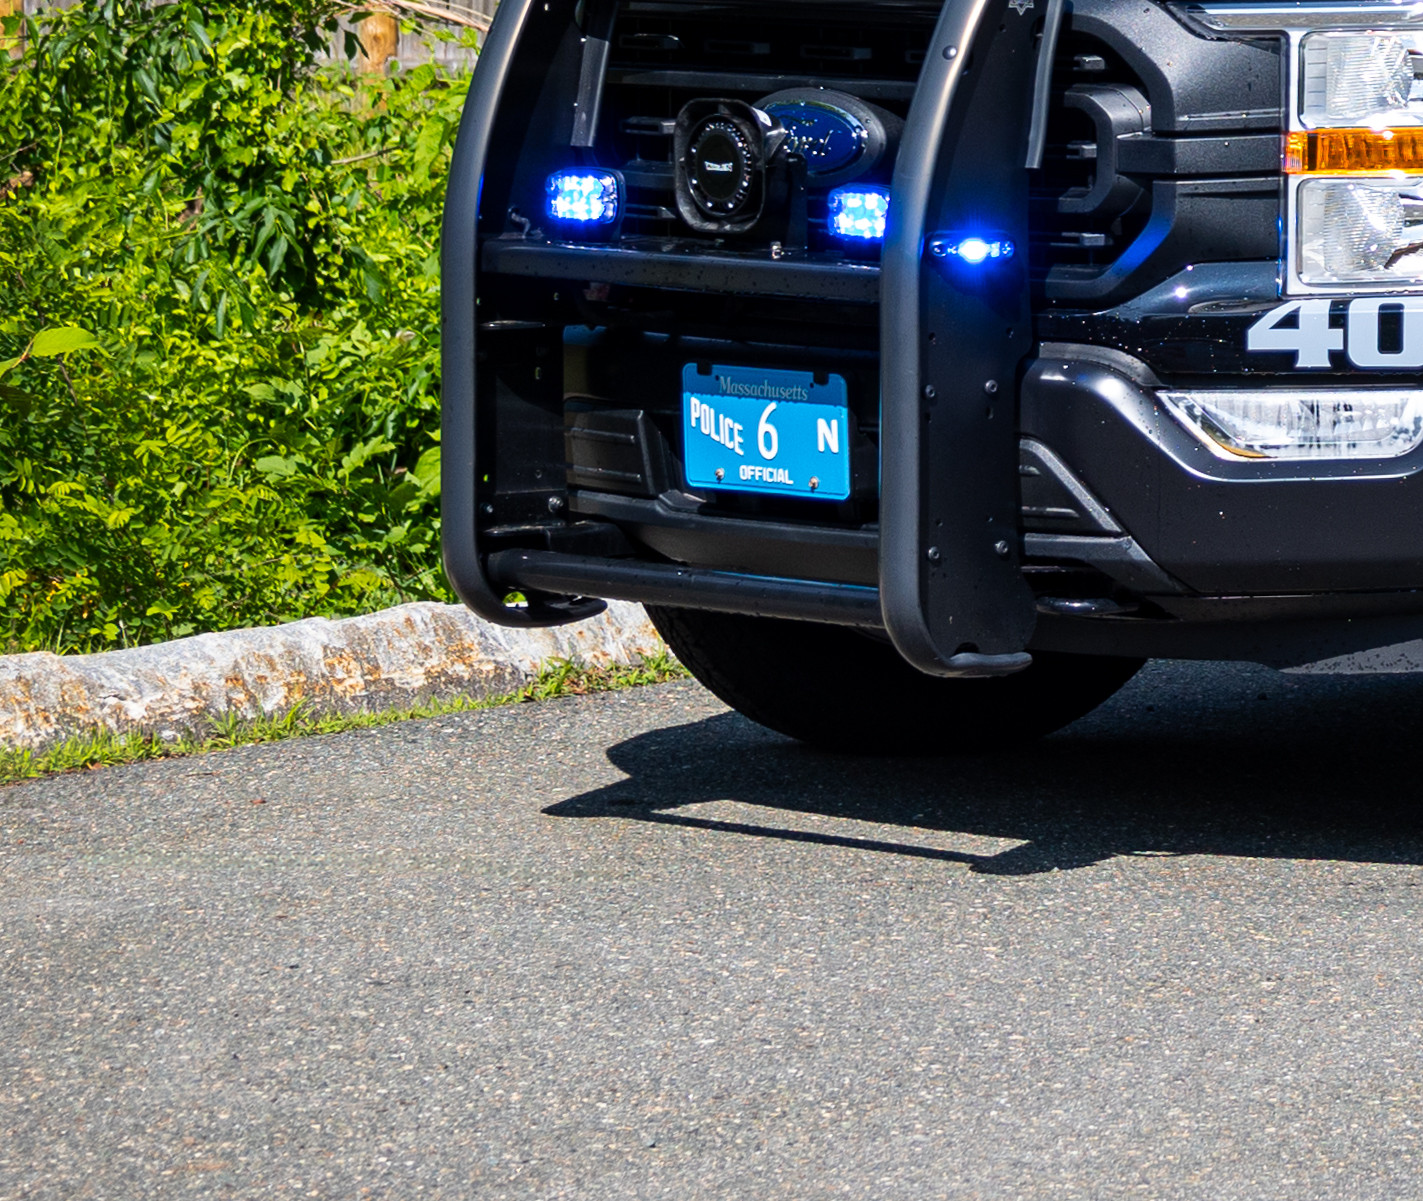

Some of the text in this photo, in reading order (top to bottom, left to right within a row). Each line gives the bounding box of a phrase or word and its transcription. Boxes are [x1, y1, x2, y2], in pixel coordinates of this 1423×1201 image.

[719, 375, 809, 401] Massachusetts
[690, 396, 839, 460] POLICE 6 N
[739, 465, 794, 485] OFFICIAL
